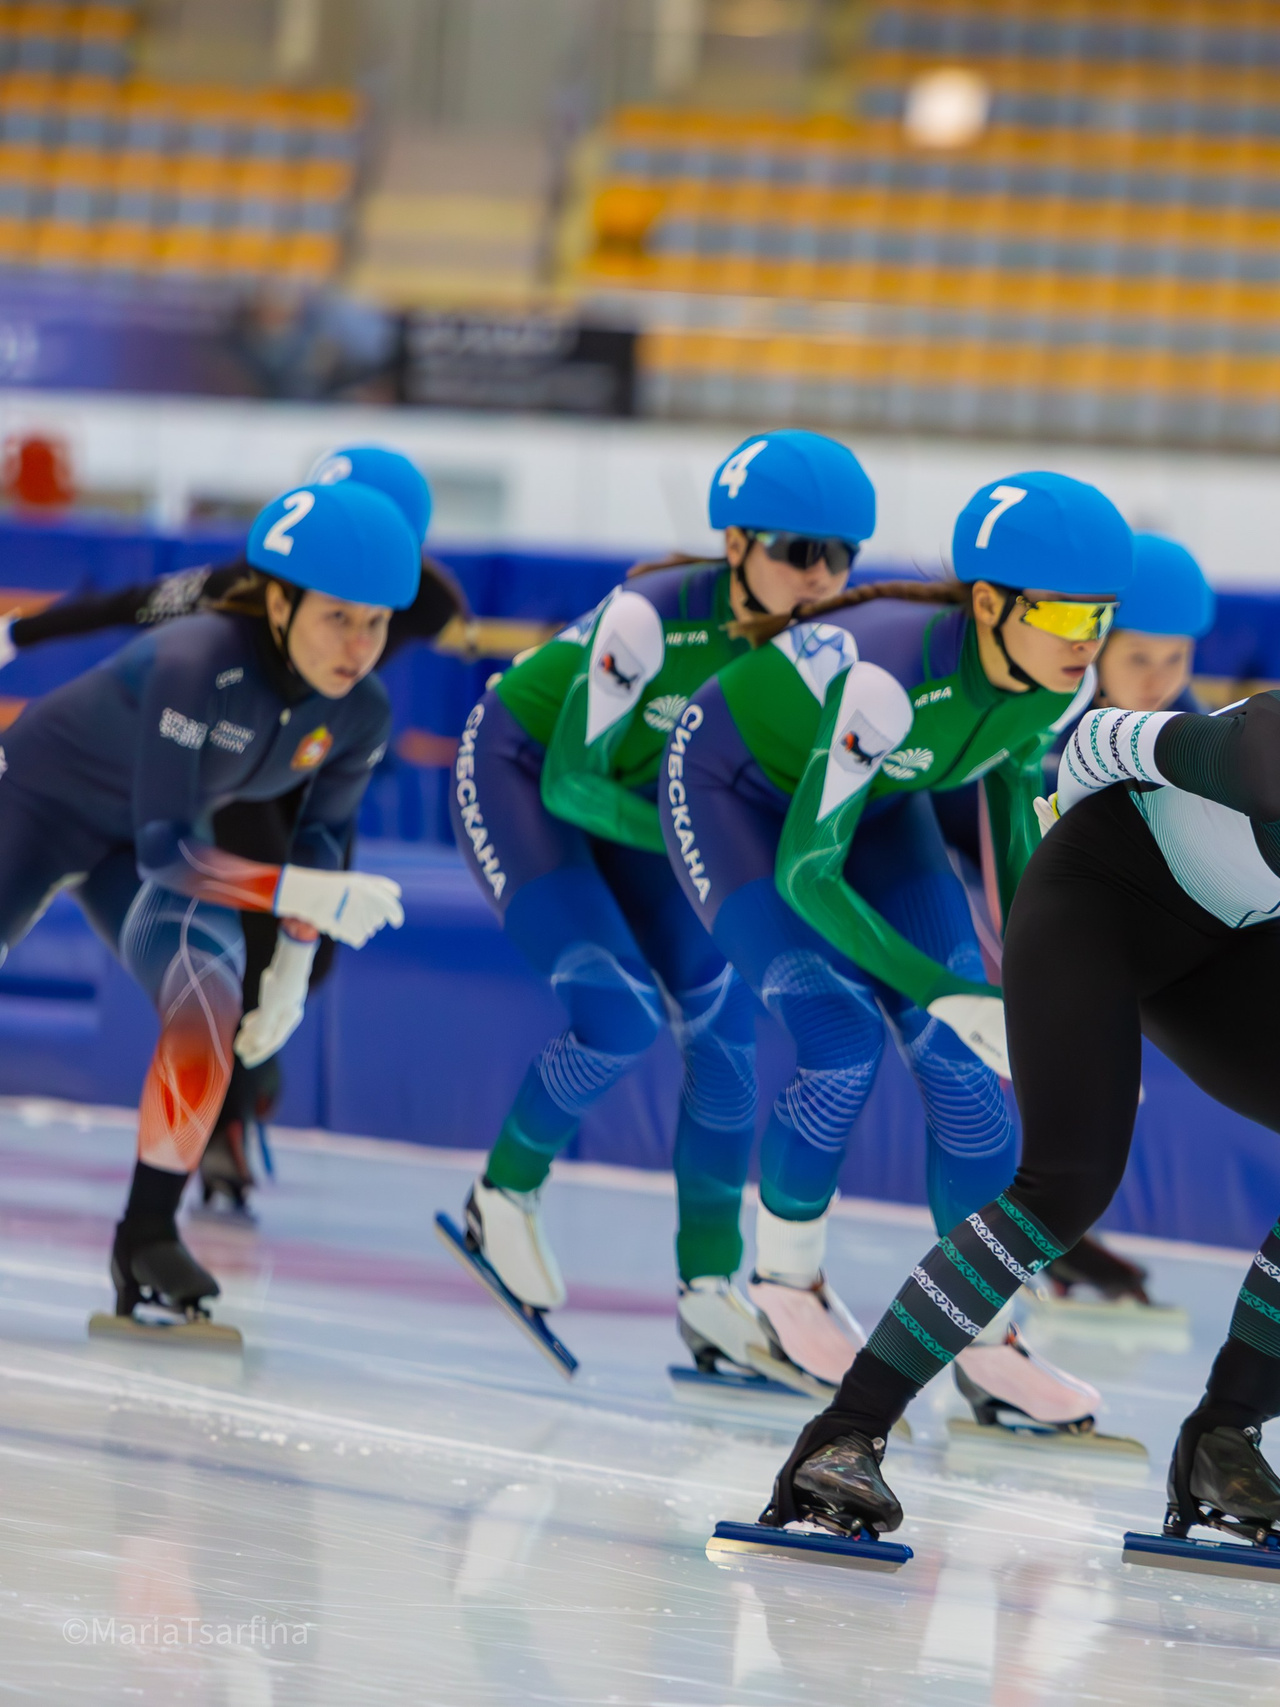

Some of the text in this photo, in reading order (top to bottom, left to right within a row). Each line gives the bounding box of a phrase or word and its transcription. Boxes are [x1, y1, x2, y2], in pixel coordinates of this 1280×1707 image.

[718, 440, 769, 499] 4
[263, 490, 316, 556] 2
[975, 485, 1028, 549] 7
[456, 703, 506, 901] СИБСКАНА
[668, 704, 711, 905] СИБСКАНА
